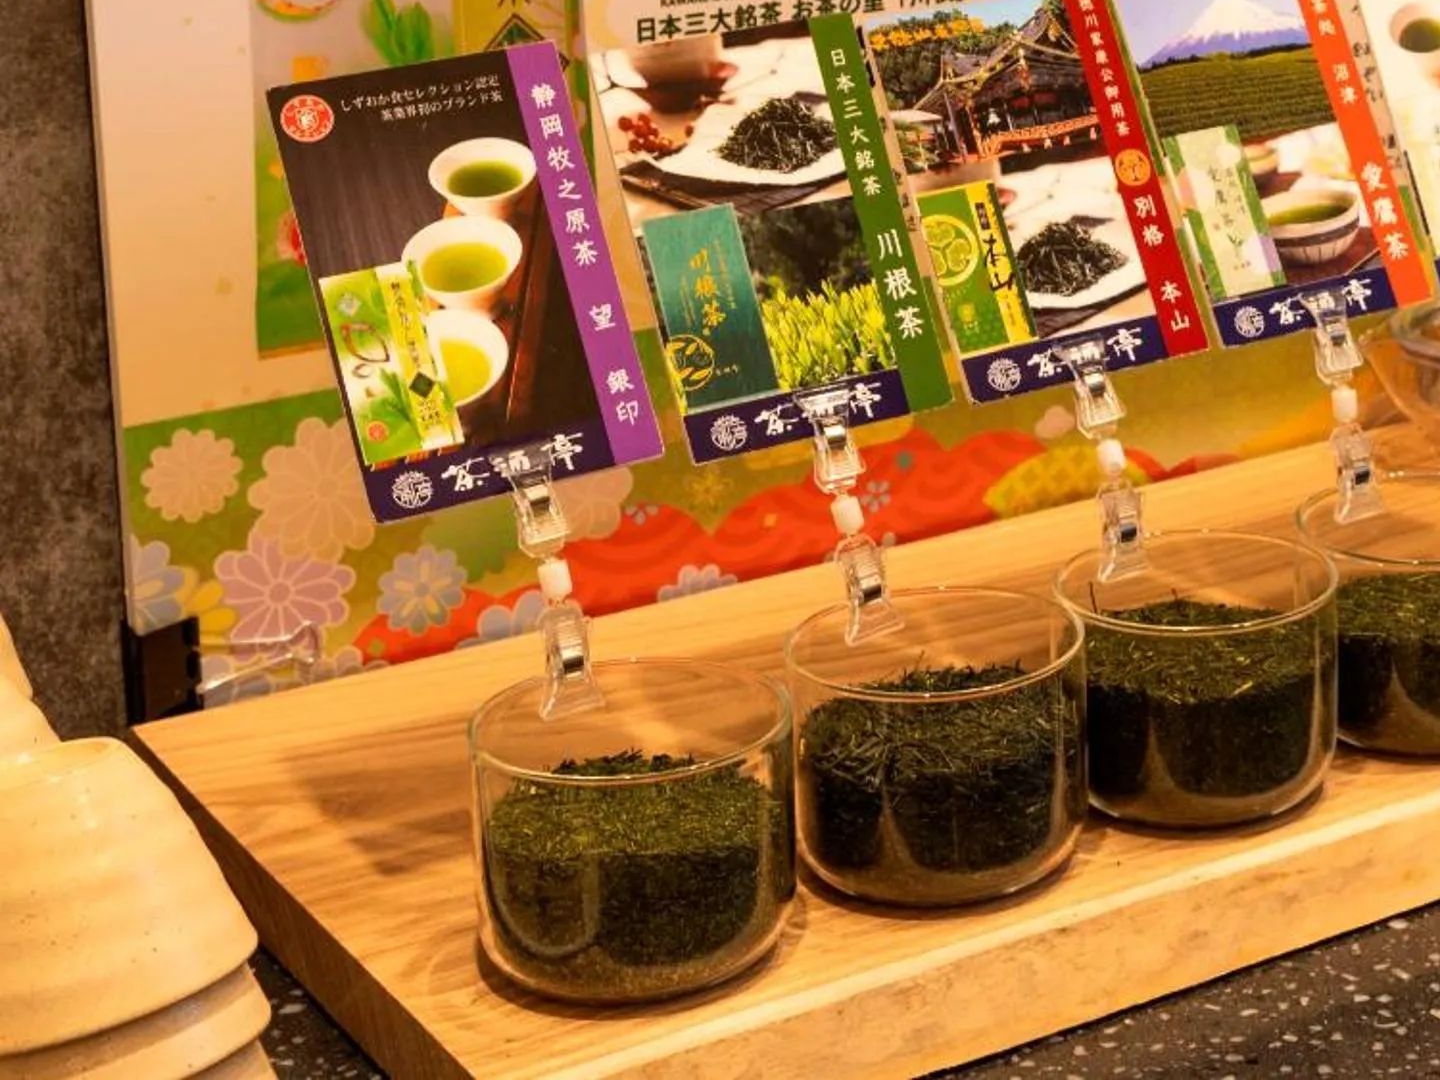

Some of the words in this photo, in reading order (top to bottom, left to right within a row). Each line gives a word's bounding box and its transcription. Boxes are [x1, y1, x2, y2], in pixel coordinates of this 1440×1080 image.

[529, 81, 600, 268] 静岡牧之原茶
[587, 303, 617, 332] 望
[604, 368, 640, 427] 銀印
[830, 48, 883, 198] 日本三大銘茶
[875, 231, 925, 340] 川根茶
[1133, 194, 1165, 248] 別格
[1160, 280, 1191, 332] 本山
